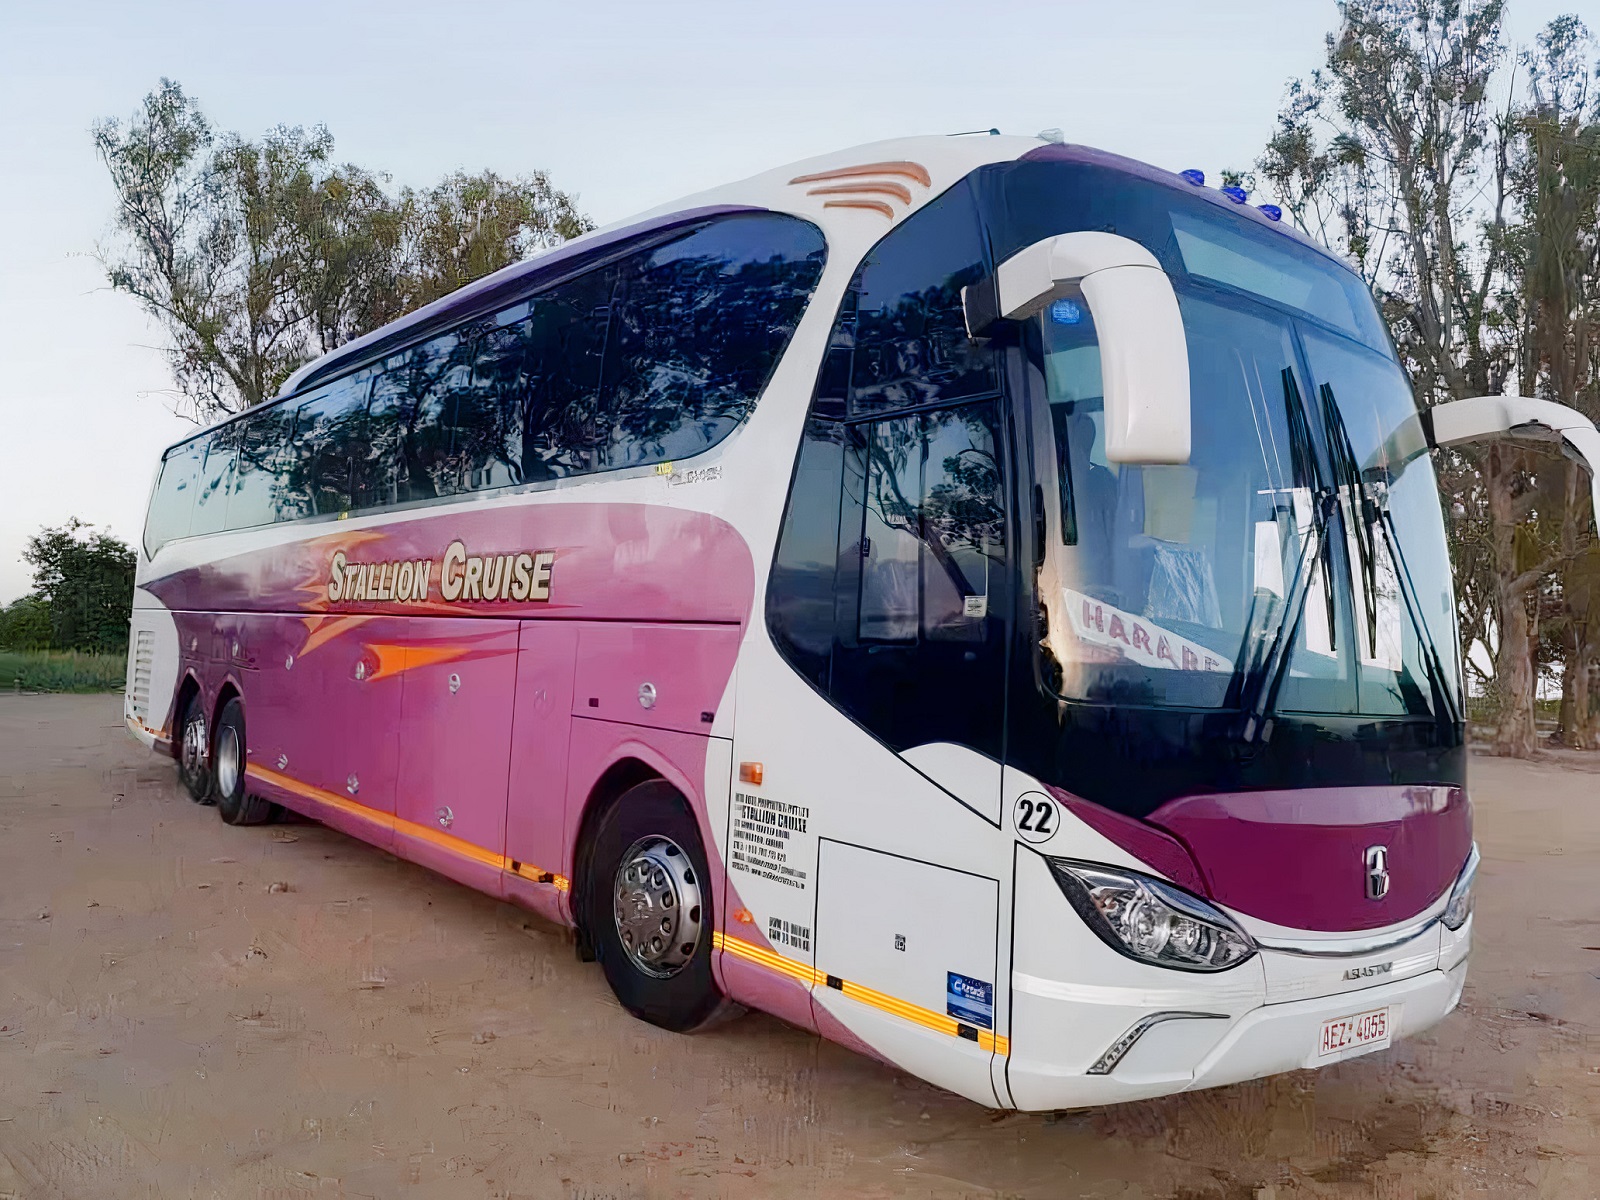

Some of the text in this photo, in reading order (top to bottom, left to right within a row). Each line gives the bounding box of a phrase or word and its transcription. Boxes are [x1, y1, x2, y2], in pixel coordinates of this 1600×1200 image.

[329, 540, 553, 602] STALLION CRUISE
[1019, 799, 1052, 833] 22
[1356, 1013, 1386, 1041] 4055
